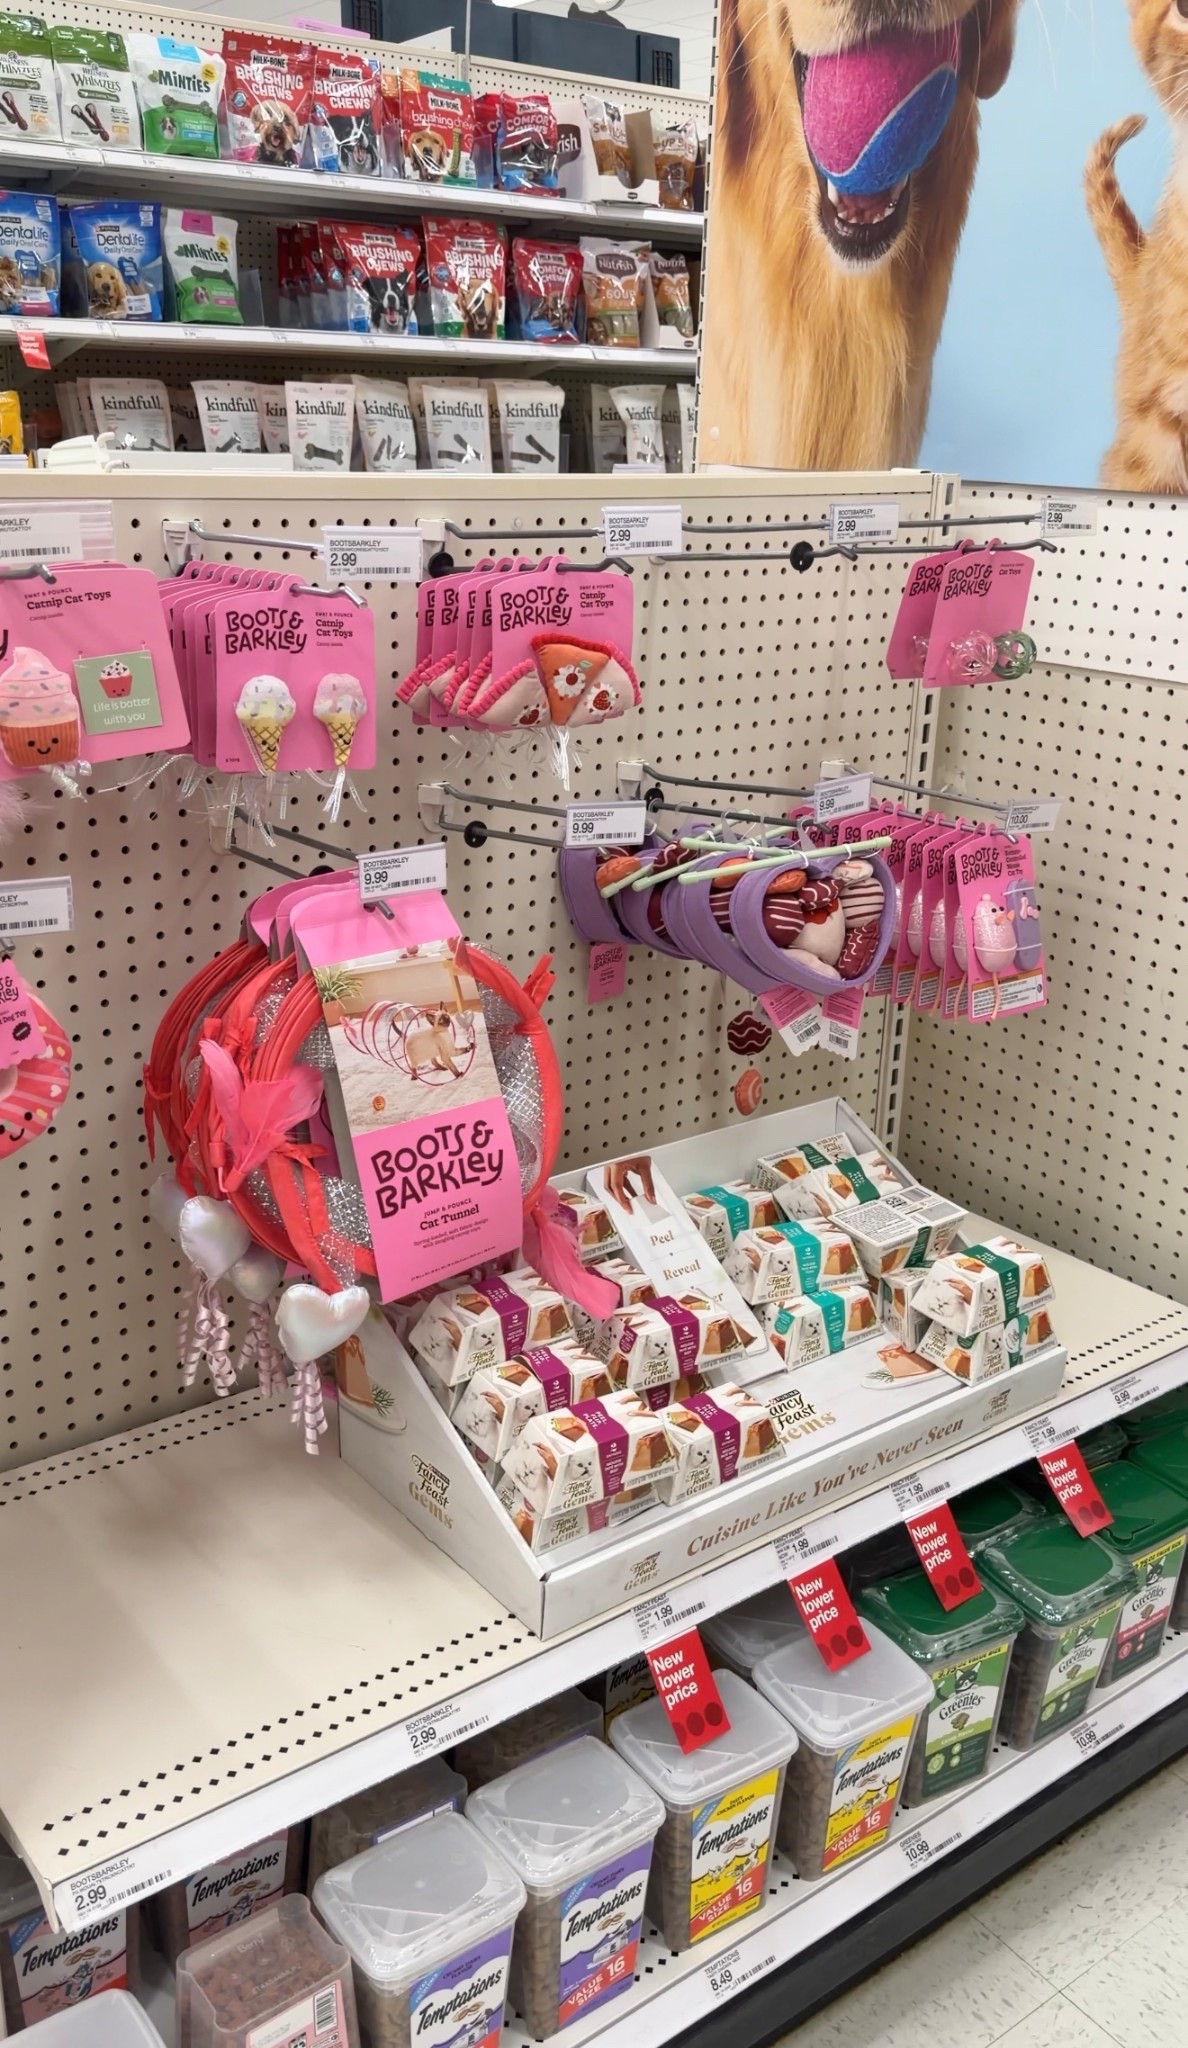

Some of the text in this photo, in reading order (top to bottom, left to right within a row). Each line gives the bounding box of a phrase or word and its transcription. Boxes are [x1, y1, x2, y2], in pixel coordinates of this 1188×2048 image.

[252, 82, 294, 101] CHEWS
[330, 96, 371, 110] CHEWS
[351, 244, 414, 262] BRUSHING
[608, 516, 649, 525] BOOTSBARKLEY
[837, 519, 856, 532] 2.99
[1047, 512, 1063, 523] 2.99
[329, 539, 381, 547] BOOTSBARKLEY
[609, 529, 631, 542] 2.99
[330, 552, 357, 567] 2.99
[948, 563, 993, 584] BOOTS &
[27, 590, 112, 611] Catnip Cat Toys
[500, 586, 569, 612] BOOTS &
[596, 599, 614, 608] Toys
[226, 607, 304, 632] BOOTS &
[315, 618, 344, 629] Catnip
[316, 628, 353, 638] Cat Toys
[93, 702, 111, 713] Life
[111, 700, 119, 710] is
[103, 712, 146, 725] with you
[572, 810, 615, 819] BOOTSBARKLEY
[819, 798, 835, 811] 9.99
[572, 822, 594, 834] 9.99
[1010, 814, 1029, 825] 10.00
[363, 856, 409, 869] BOOTSBARKLEY
[961, 847, 990, 869] BOOTS
[991, 846, 1000, 861] &
[364, 870, 388, 885] 9.99
[371, 1120, 494, 1184] BOOTS &
[419, 1204, 480, 1231] Cat Tunnel
[424, 1198, 472, 1219] JUMP POUNCE
[650, 1230, 675, 1246] Peel
[663, 1259, 702, 1281] Reveal
[768, 1275, 792, 1287] Fancy
[470, 1347, 497, 1361] Fancy
[644, 1358, 670, 1373] Fancy
[765, 1394, 804, 1418] ancy
[777, 1389, 800, 1403] PURINA
[1114, 1390, 1131, 1405] 9.99
[770, 1403, 817, 1431] Feast
[778, 1411, 837, 1445] ems
[1041, 1426, 1056, 1439] 1.99
[411, 1454, 449, 1496] Fancy
[1043, 1457, 1068, 1475] New
[563, 1478, 593, 1495] Fancy
[687, 1419, 964, 1557] Cuisine Like You've Never Seen
[1050, 1468, 1078, 1489] lower
[418, 1473, 450, 1509] Feast
[907, 1482, 924, 1497] 1.99
[1058, 1483, 1083, 1504] price
[408, 1482, 454, 1529] Gems
[562, 1492, 597, 1510] Gems
[551, 1514, 578, 1530] Fancy
[911, 1521, 938, 1542] New
[551, 1528, 583, 1546] Gems
[792, 1538, 809, 1553] 1.99
[917, 1532, 948, 1557] lower
[924, 1548, 952, 1573] price
[794, 1577, 823, 1600] New
[633, 1599, 651, 1613] FANCY
[650, 1592, 668, 1605] FEAST
[801, 1589, 835, 1615] lower
[654, 1604, 673, 1622] 1.99
[808, 1606, 839, 1633] price
[652, 1650, 684, 1675] New
[1058, 1646, 1093, 1674] Greenies
[658, 1663, 695, 1691] lower
[665, 1682, 699, 1711] price
[939, 1692, 982, 1721] Greenies
[405, 1703, 453, 1731] BOOTSBARKLEY
[410, 1726, 437, 1749] 2.99
[1075, 1730, 1097, 1749] 10.99
[835, 1747, 903, 1796] Temptations
[865, 1810, 881, 1829] 16
[696, 1804, 770, 1860] Temptations
[832, 1825, 862, 1852] VALUE
[899, 1830, 922, 1848] GREENIES
[838, 1834, 860, 1853] SIZE
[905, 1840, 930, 1862] 10.99
[70, 1857, 131, 1892] BOOTSBARKLEY
[191, 1851, 280, 1908] Temptations
[735, 1877, 753, 1897] 16
[74, 1885, 108, 1911] 2.99
[699, 1893, 733, 1921] VALUE
[565, 1883, 643, 1942] Temptations
[706, 1903, 731, 1923] SIZE
[22, 1916, 119, 1977] Temptations
[238, 1936, 265, 1953] Berry
[607, 1955, 625, 1977] 16
[704, 1949, 740, 1975] TEMPTATIONS
[568, 1974, 604, 2005] VALUE
[710, 1969, 733, 1991] 8.49
[416, 1969, 503, 2036] Temptations
[577, 1985, 602, 2007] SIZE
